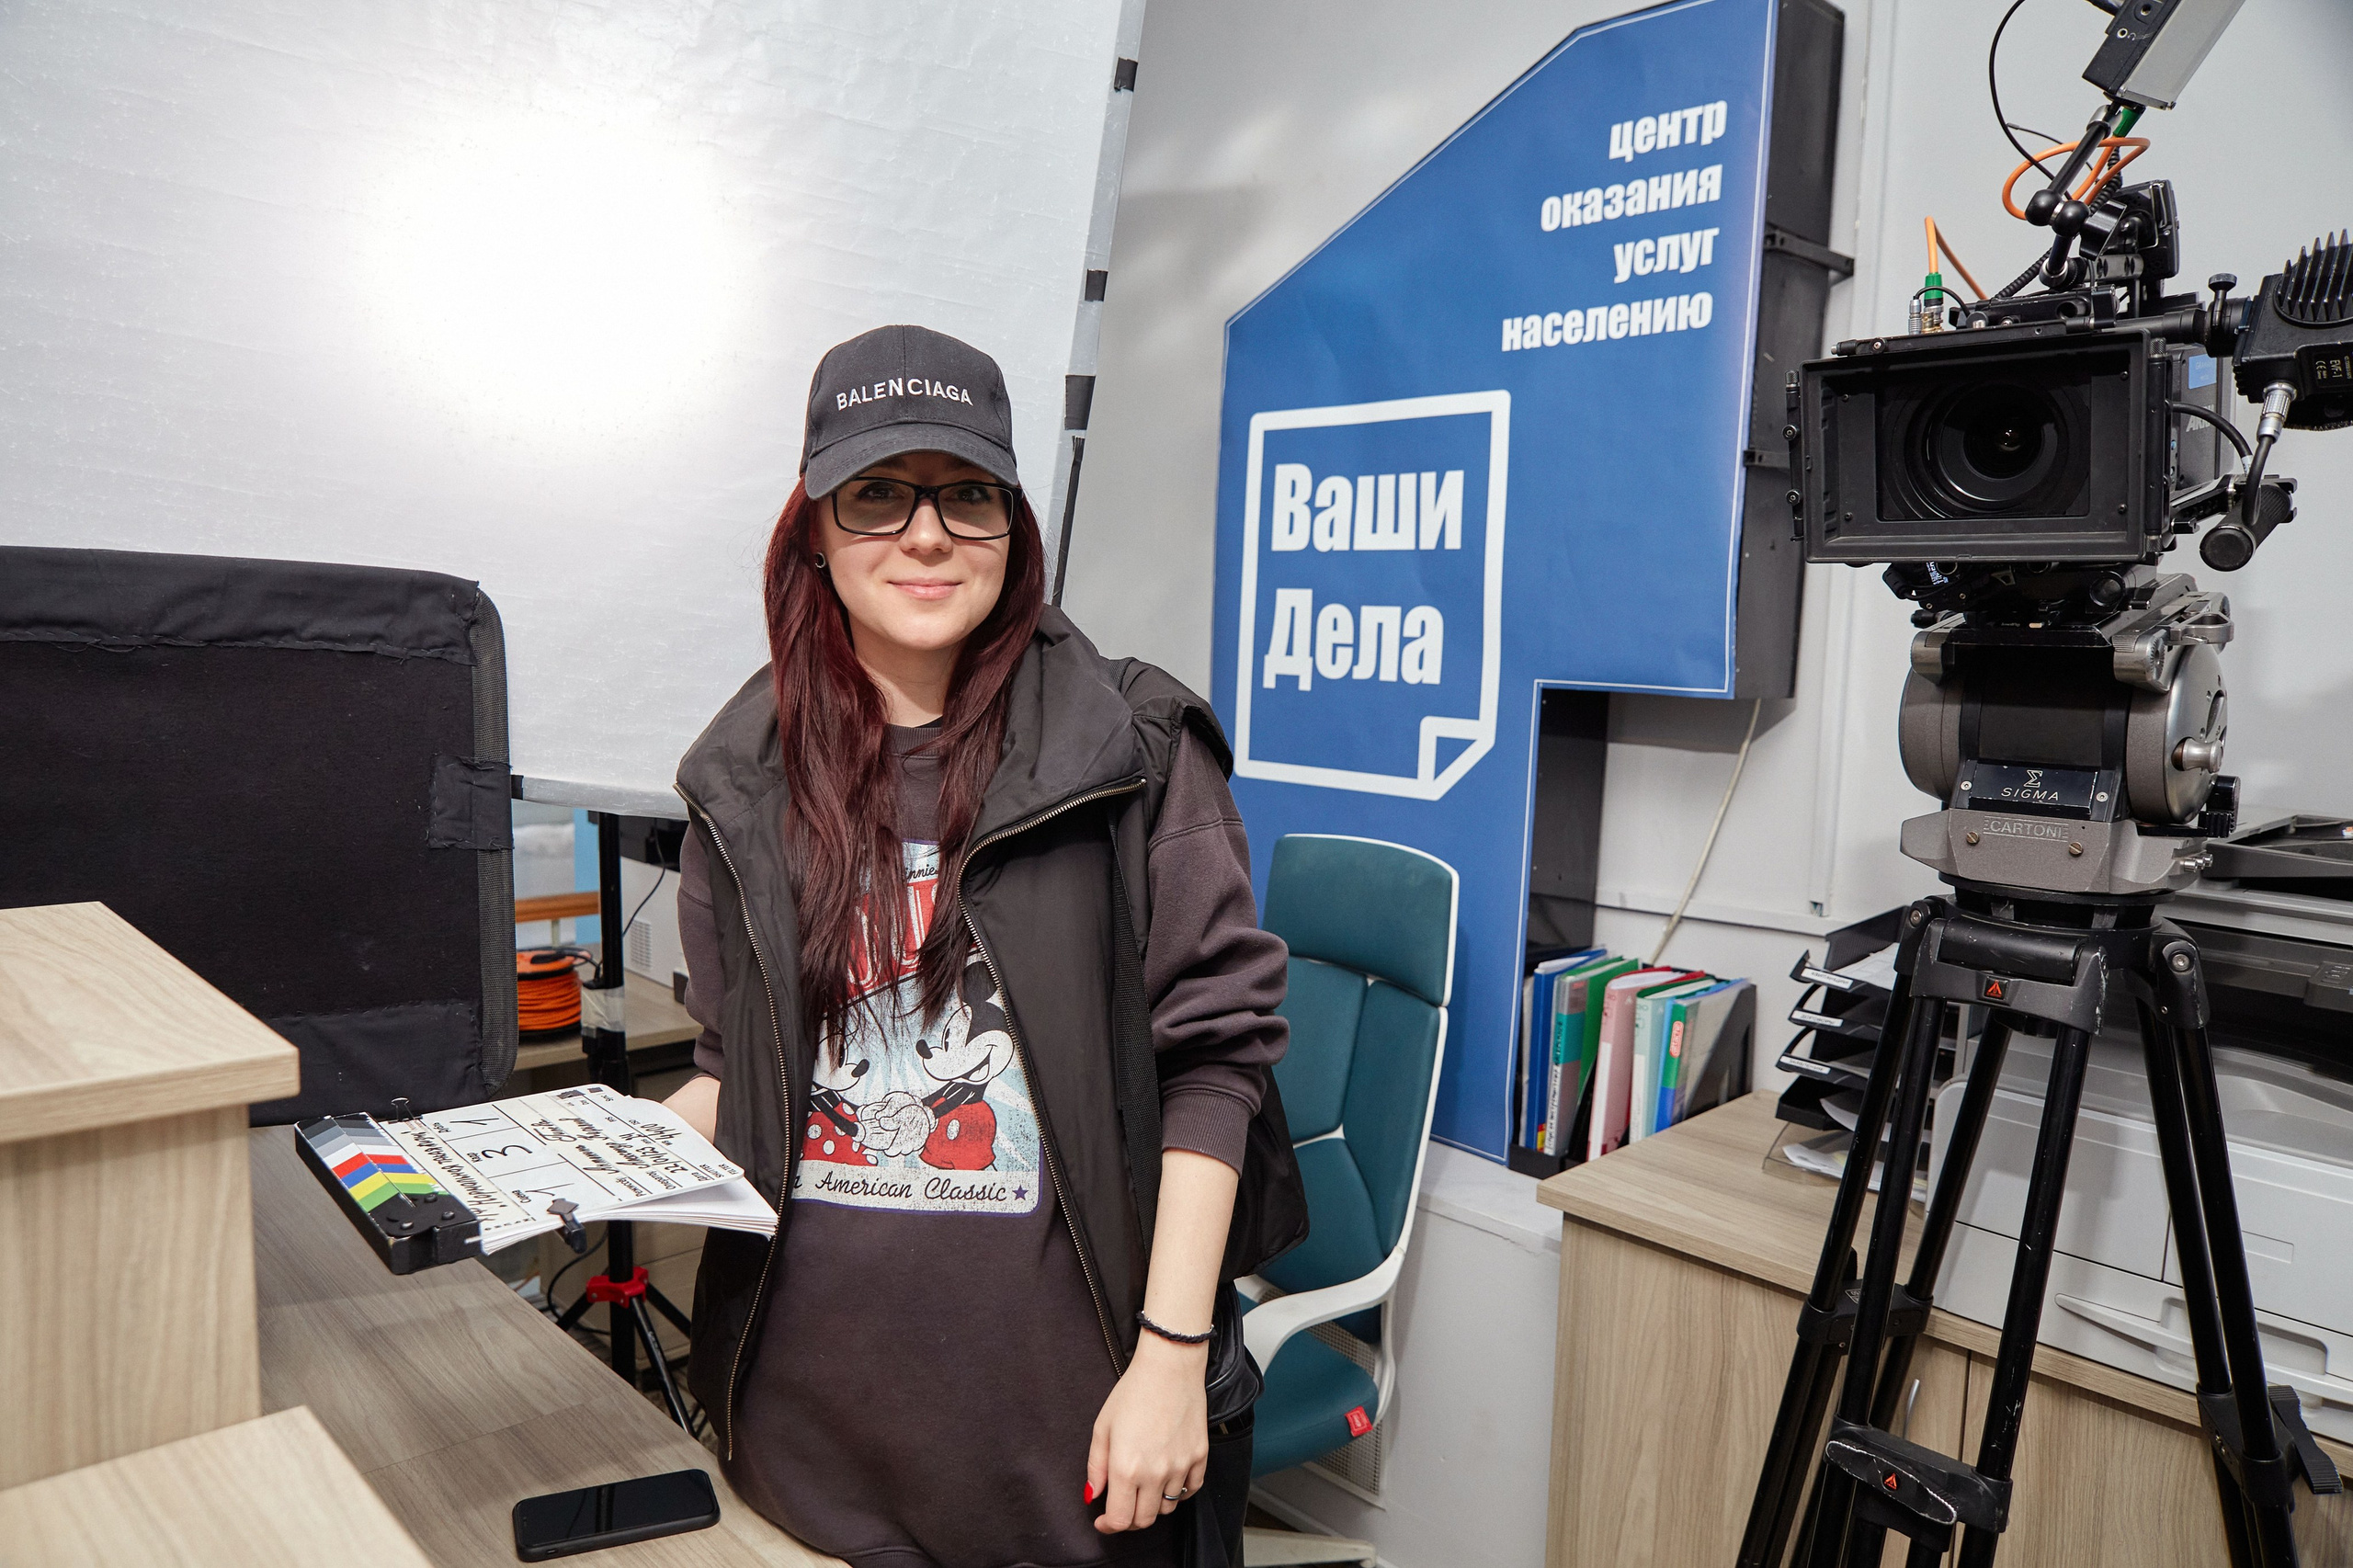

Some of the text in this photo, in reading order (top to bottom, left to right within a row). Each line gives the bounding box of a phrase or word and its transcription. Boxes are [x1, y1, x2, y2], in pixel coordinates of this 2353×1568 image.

[1609, 100, 1728, 163] центр
[1540, 164, 1723, 233] оказания
[1614, 227, 1720, 284] услуг
[1501, 291, 1714, 352] населению
[835, 378, 974, 412] BALENCIAGA
[1271, 463, 1465, 553] Ваши
[1263, 588, 1445, 692] Дела
[2001, 788, 2058, 801] SIGMA
[1990, 821, 2062, 838] CARTONI
[904, 863, 938, 881] innie
[433, 1122, 451, 1133] Дубль
[467, 1153, 483, 1163] Кадр
[482, 1145, 533, 1158] 3
[691, 1171, 710, 1181] Дата
[699, 1164, 724, 1177] SHUTTER
[718, 1164, 738, 1175] FILTER
[815, 1170, 913, 1200] American
[924, 1176, 1007, 1203] Classic
[512, 1190, 531, 1203] Сцена
